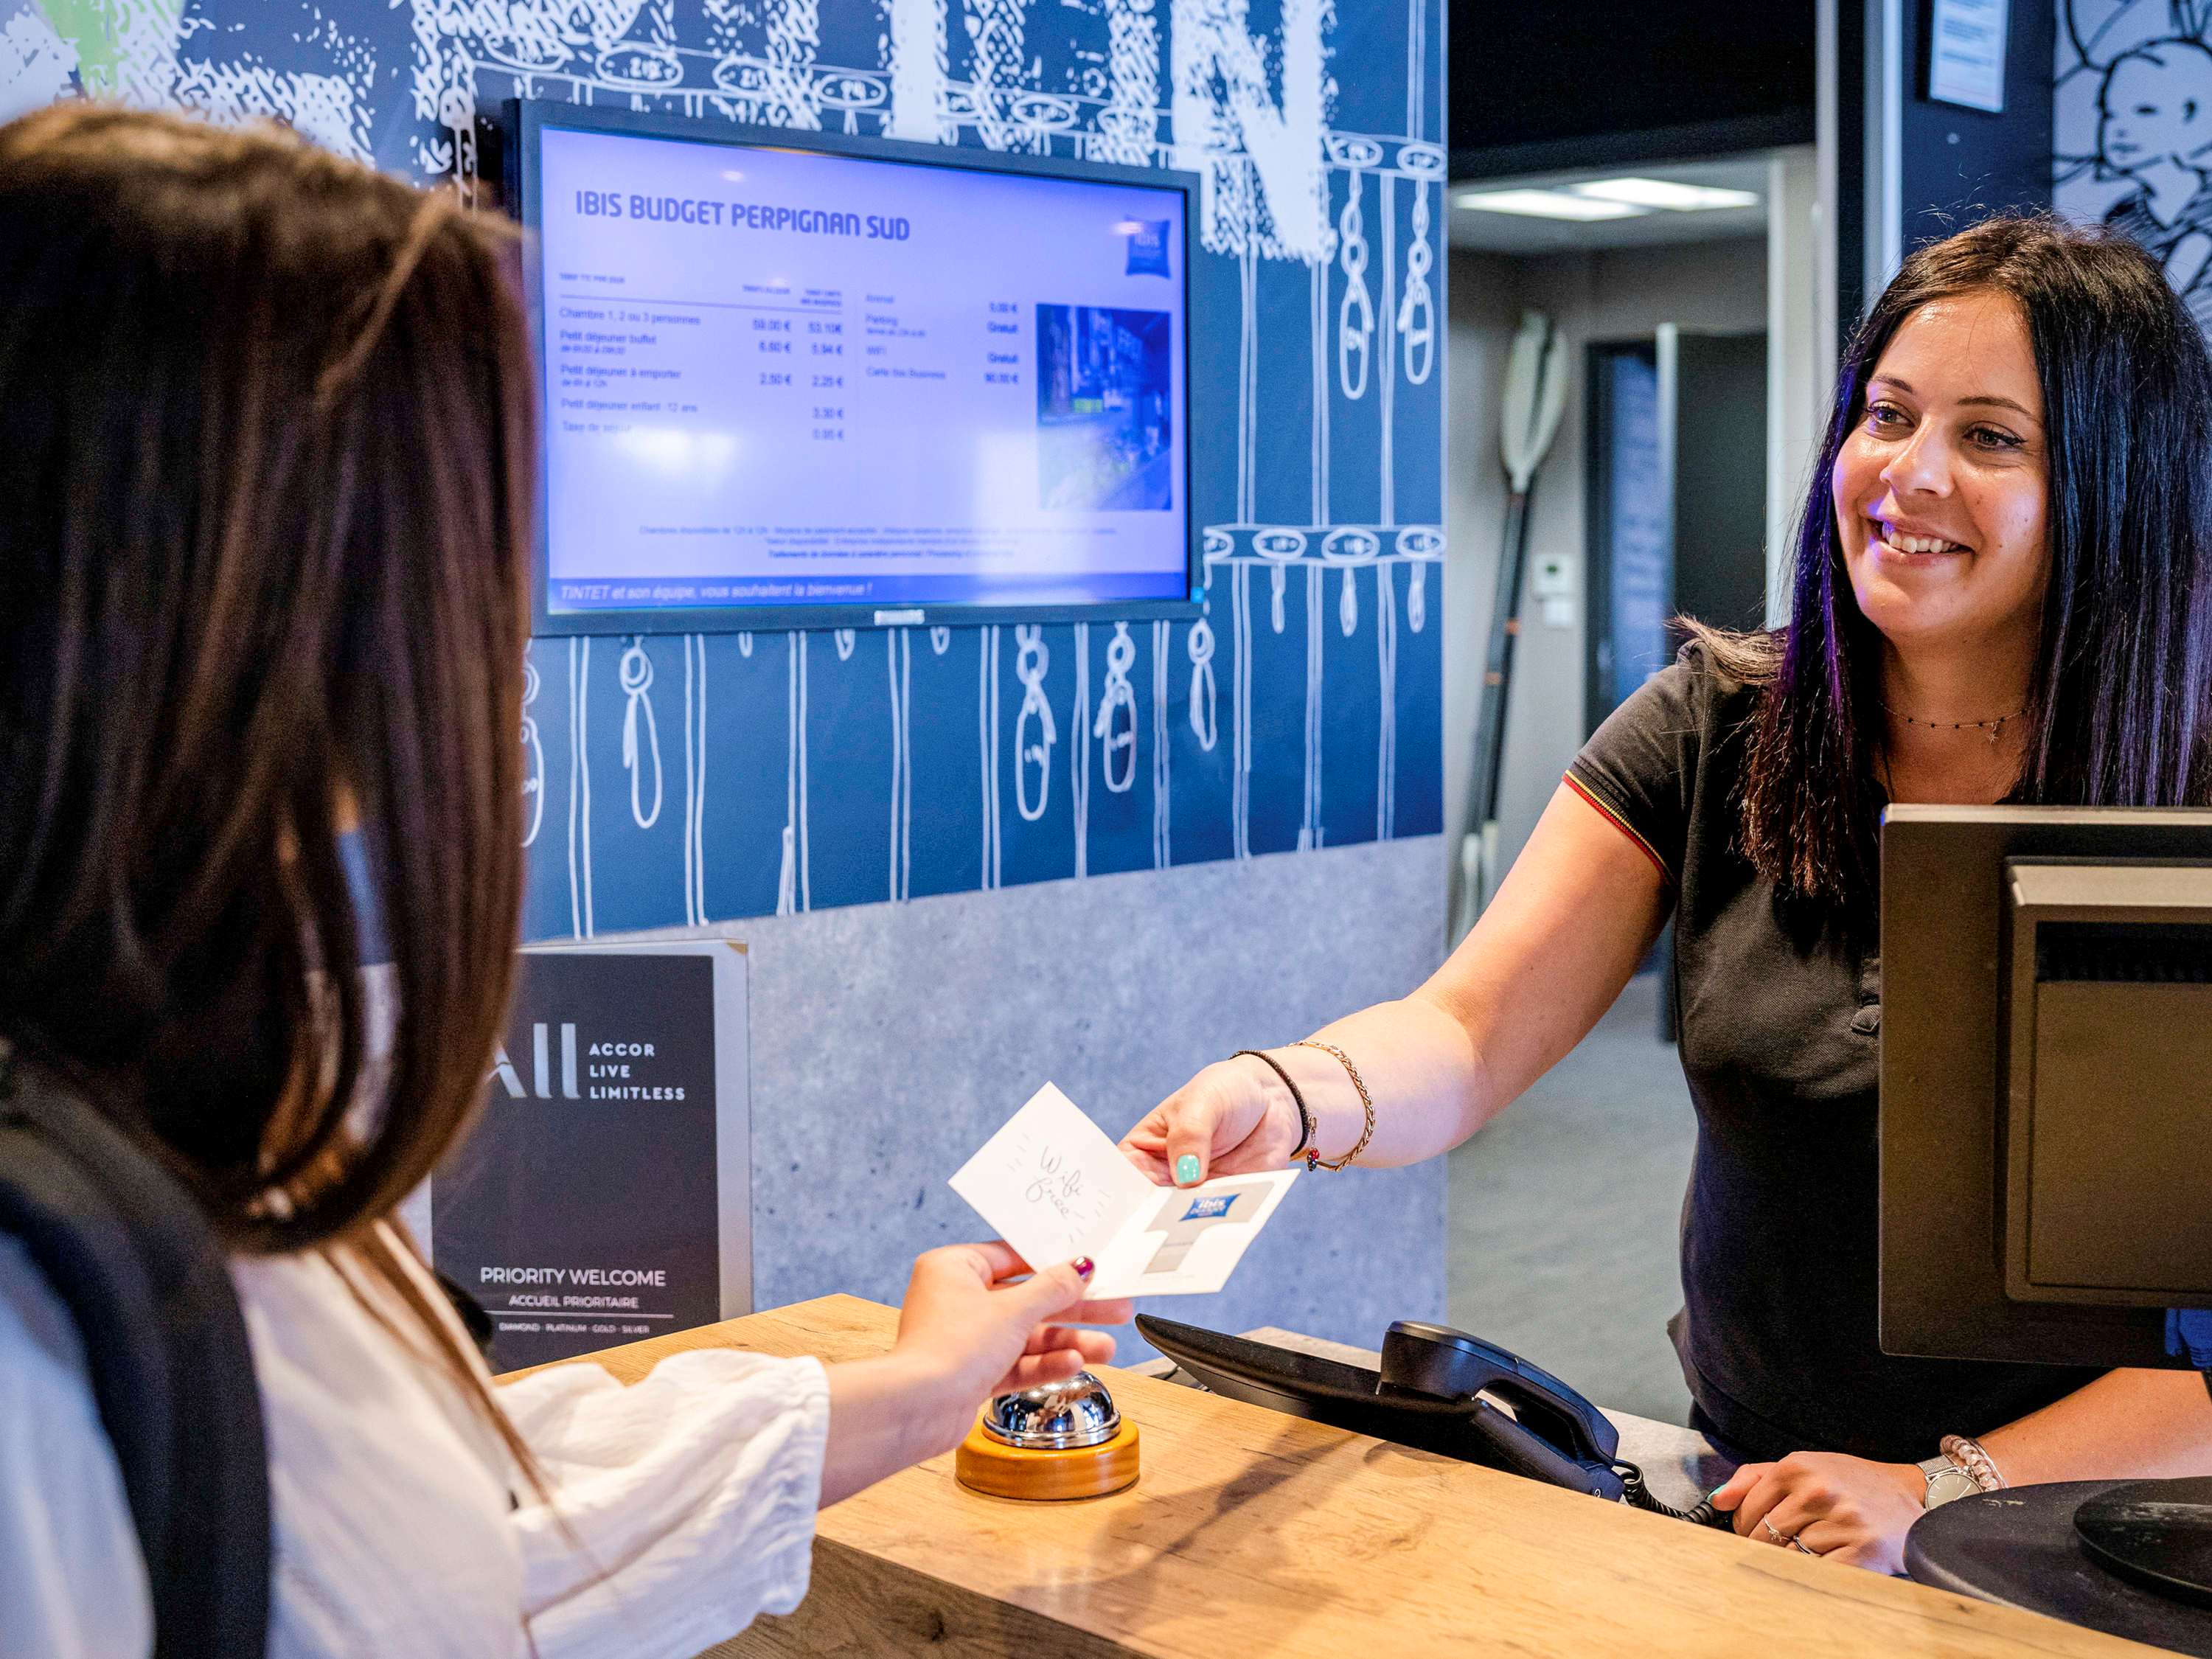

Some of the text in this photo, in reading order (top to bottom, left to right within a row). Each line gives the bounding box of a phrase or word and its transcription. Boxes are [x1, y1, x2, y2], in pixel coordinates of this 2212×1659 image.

[575, 190, 622, 218] IBIS
[630, 195, 725, 226] BUDGET
[866, 215, 911, 242] SUD
[559, 307, 605, 320] Chambre
[627, 313, 640, 322] ou
[651, 314, 701, 326] personnes
[560, 329, 582, 341] Petit
[560, 364, 582, 375] Petit
[589, 1043, 655, 1057] ACCOR
[590, 1065, 630, 1078] LIVE
[590, 1086, 685, 1100] LIMITLESS
[481, 1267, 667, 1287] PRIORITY WELCOME
[509, 1295, 639, 1309] ACCUEIL PRIORITAIRE
[498, 1322, 650, 1334] DIAMOND PLATINUM GOLD SILVER
